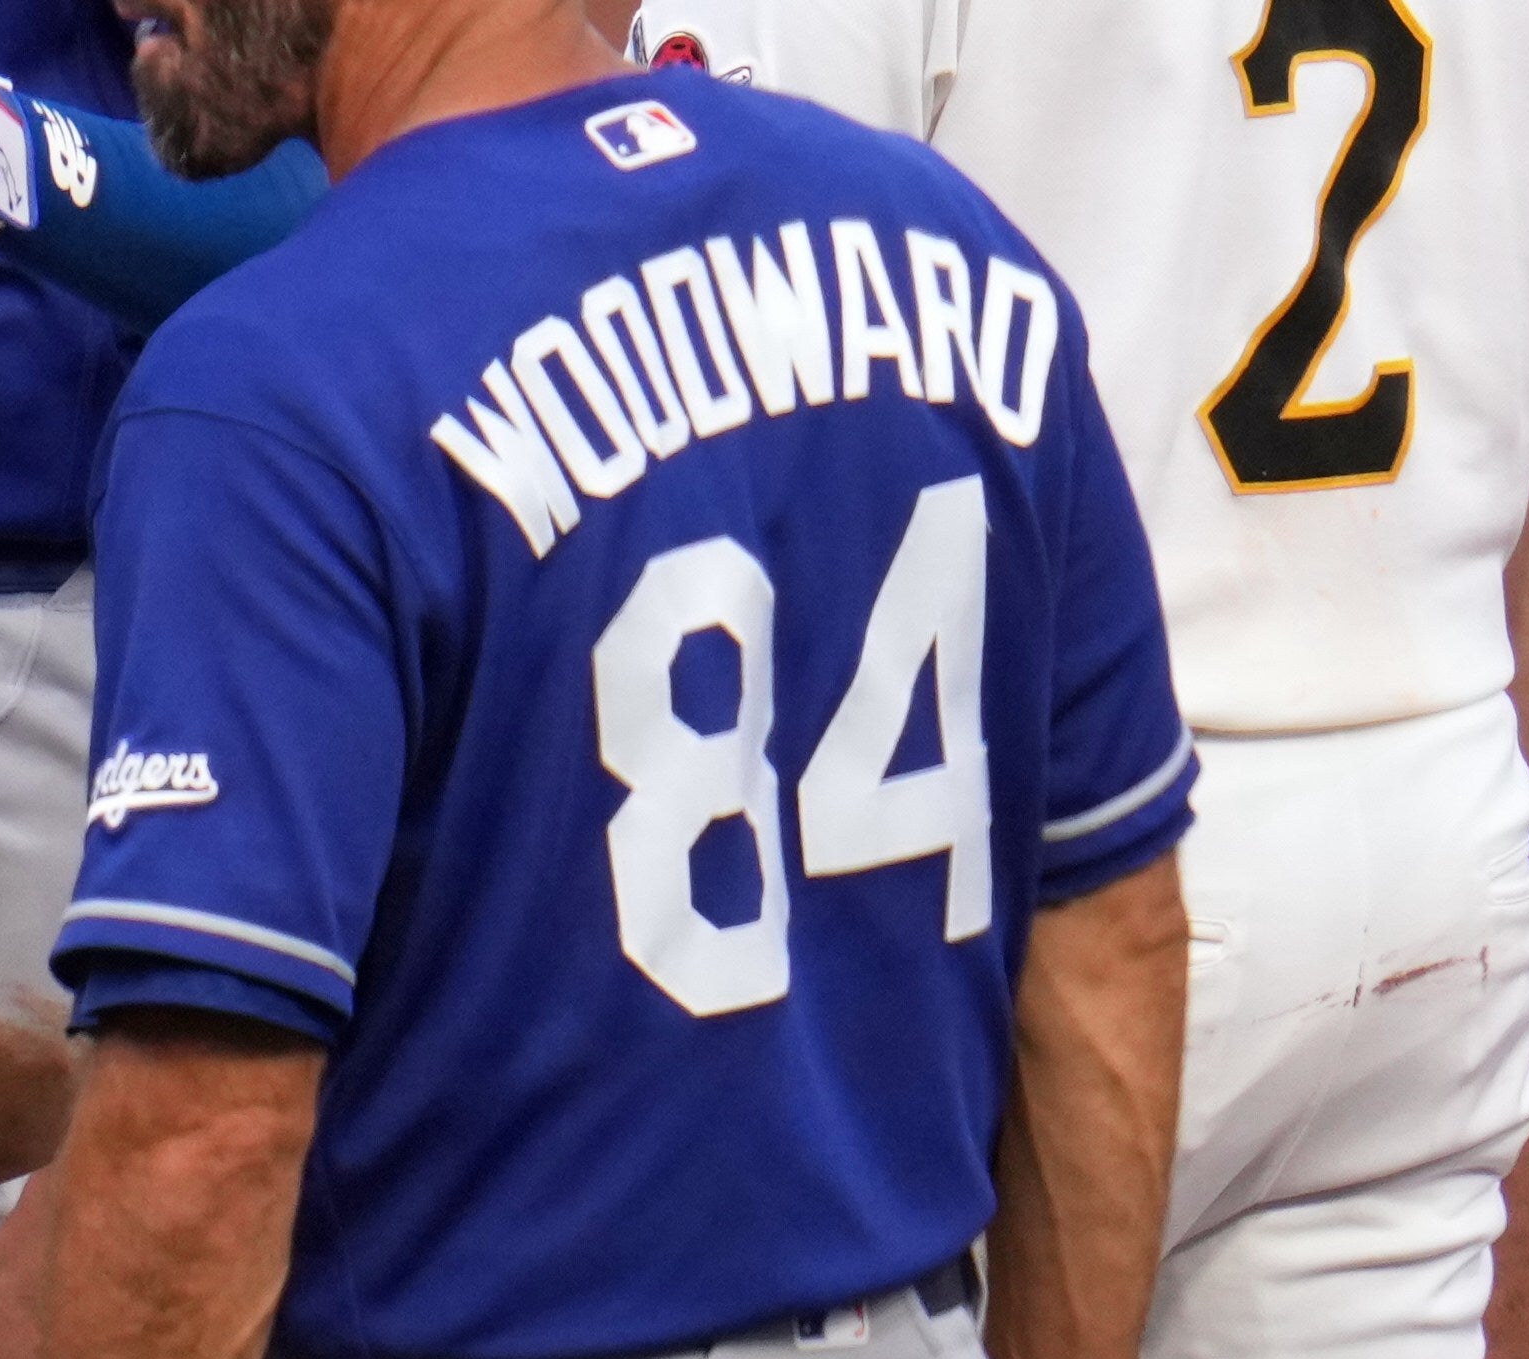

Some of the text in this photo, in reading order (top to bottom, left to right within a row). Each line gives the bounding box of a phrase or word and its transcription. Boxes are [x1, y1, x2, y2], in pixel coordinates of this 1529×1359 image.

[431, 219, 1058, 559] WOODWARD
[92, 738, 218, 828] dgers
[593, 474, 993, 1017] 84
